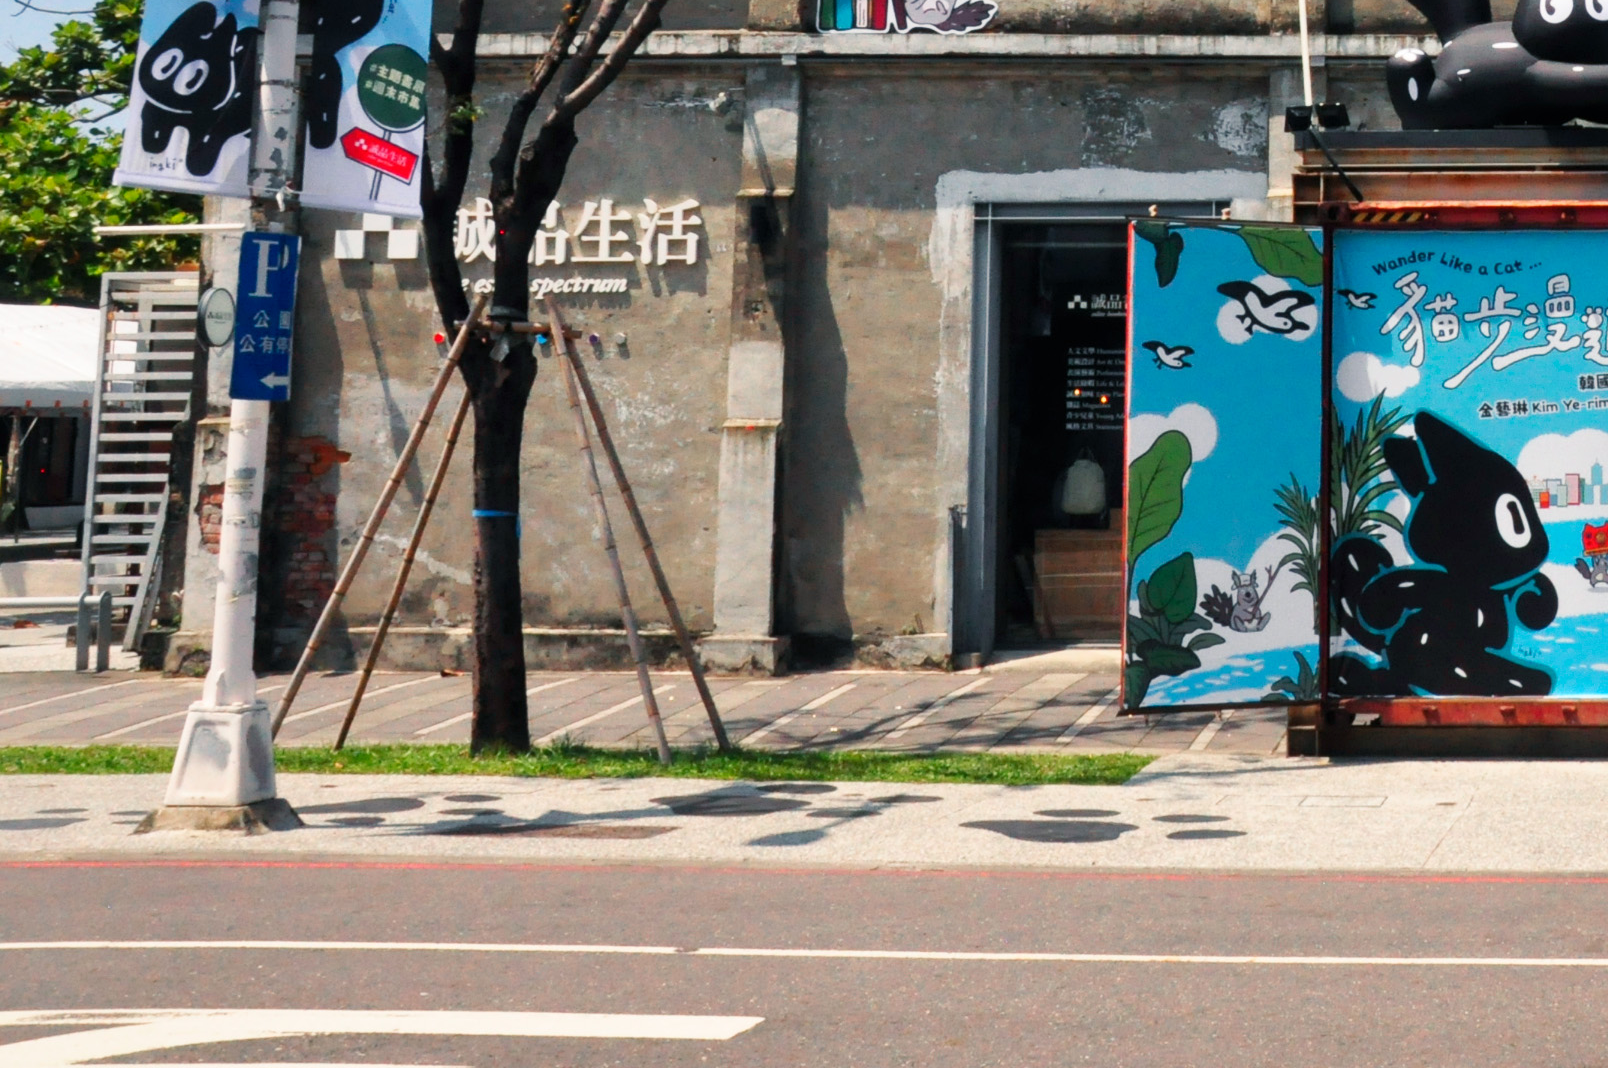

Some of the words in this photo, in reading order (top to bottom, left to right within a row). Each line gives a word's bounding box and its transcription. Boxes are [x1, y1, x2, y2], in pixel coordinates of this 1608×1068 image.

[248, 239, 290, 298] P
[1371, 249, 1436, 277] Wander
[1440, 251, 1473, 275] Like
[1478, 265, 1489, 276] a
[1493, 259, 1523, 276] Cat
[529, 276, 628, 300] spectrum
[1090, 293, 1127, 309] 誠品
[1478, 400, 1528, 419] 金藝琳
[1532, 401, 1559, 414] Kim
